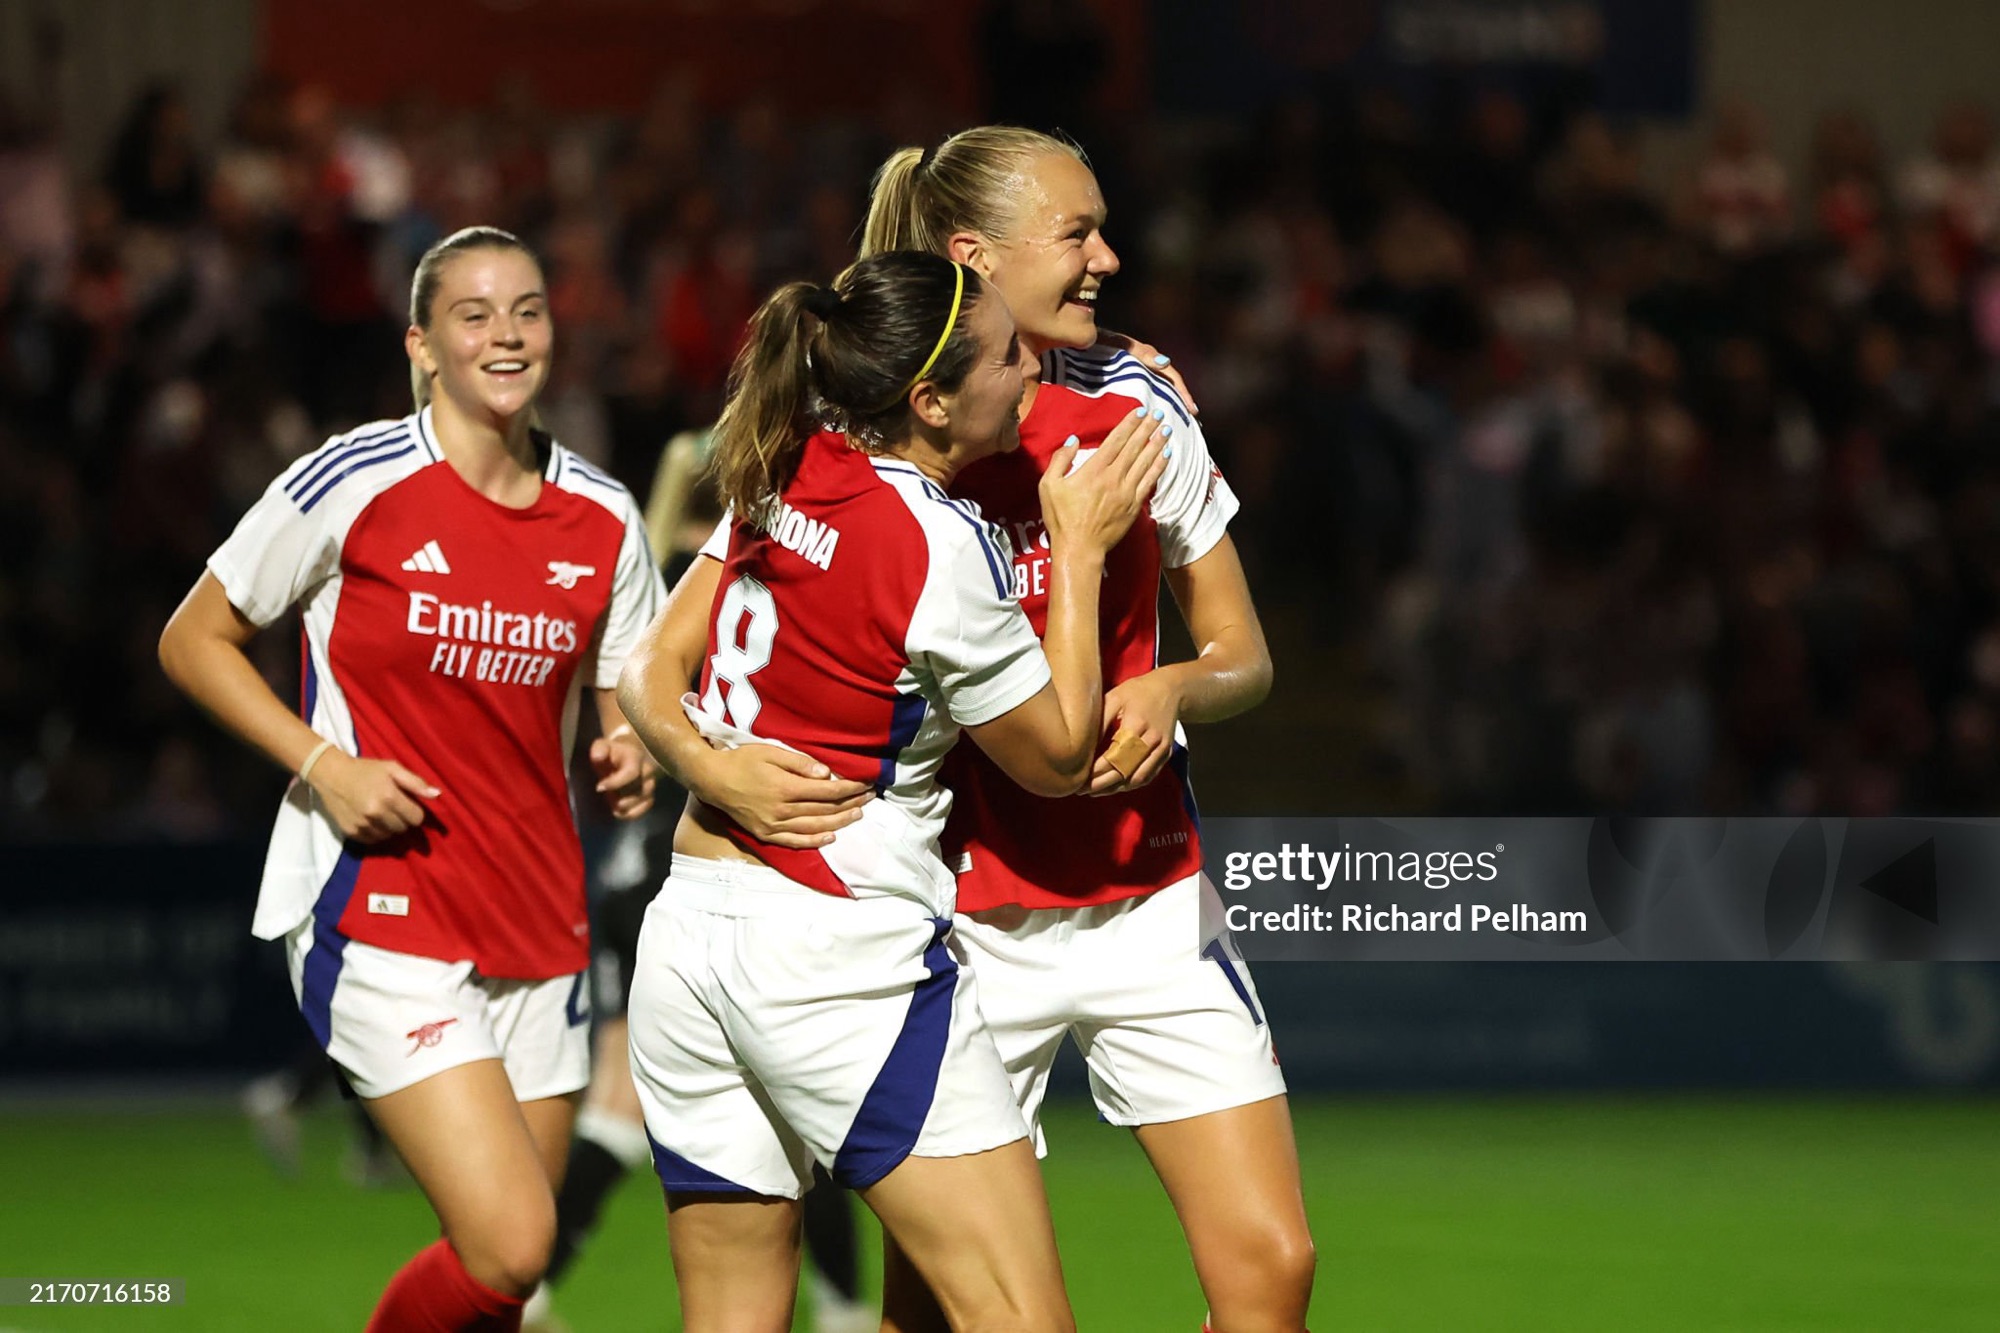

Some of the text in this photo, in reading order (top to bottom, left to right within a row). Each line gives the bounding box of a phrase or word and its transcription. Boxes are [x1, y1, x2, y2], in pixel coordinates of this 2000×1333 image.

[408, 591, 577, 653] Emirates
[701, 572, 779, 734] 8
[429, 642, 556, 687] FLY BETTER
